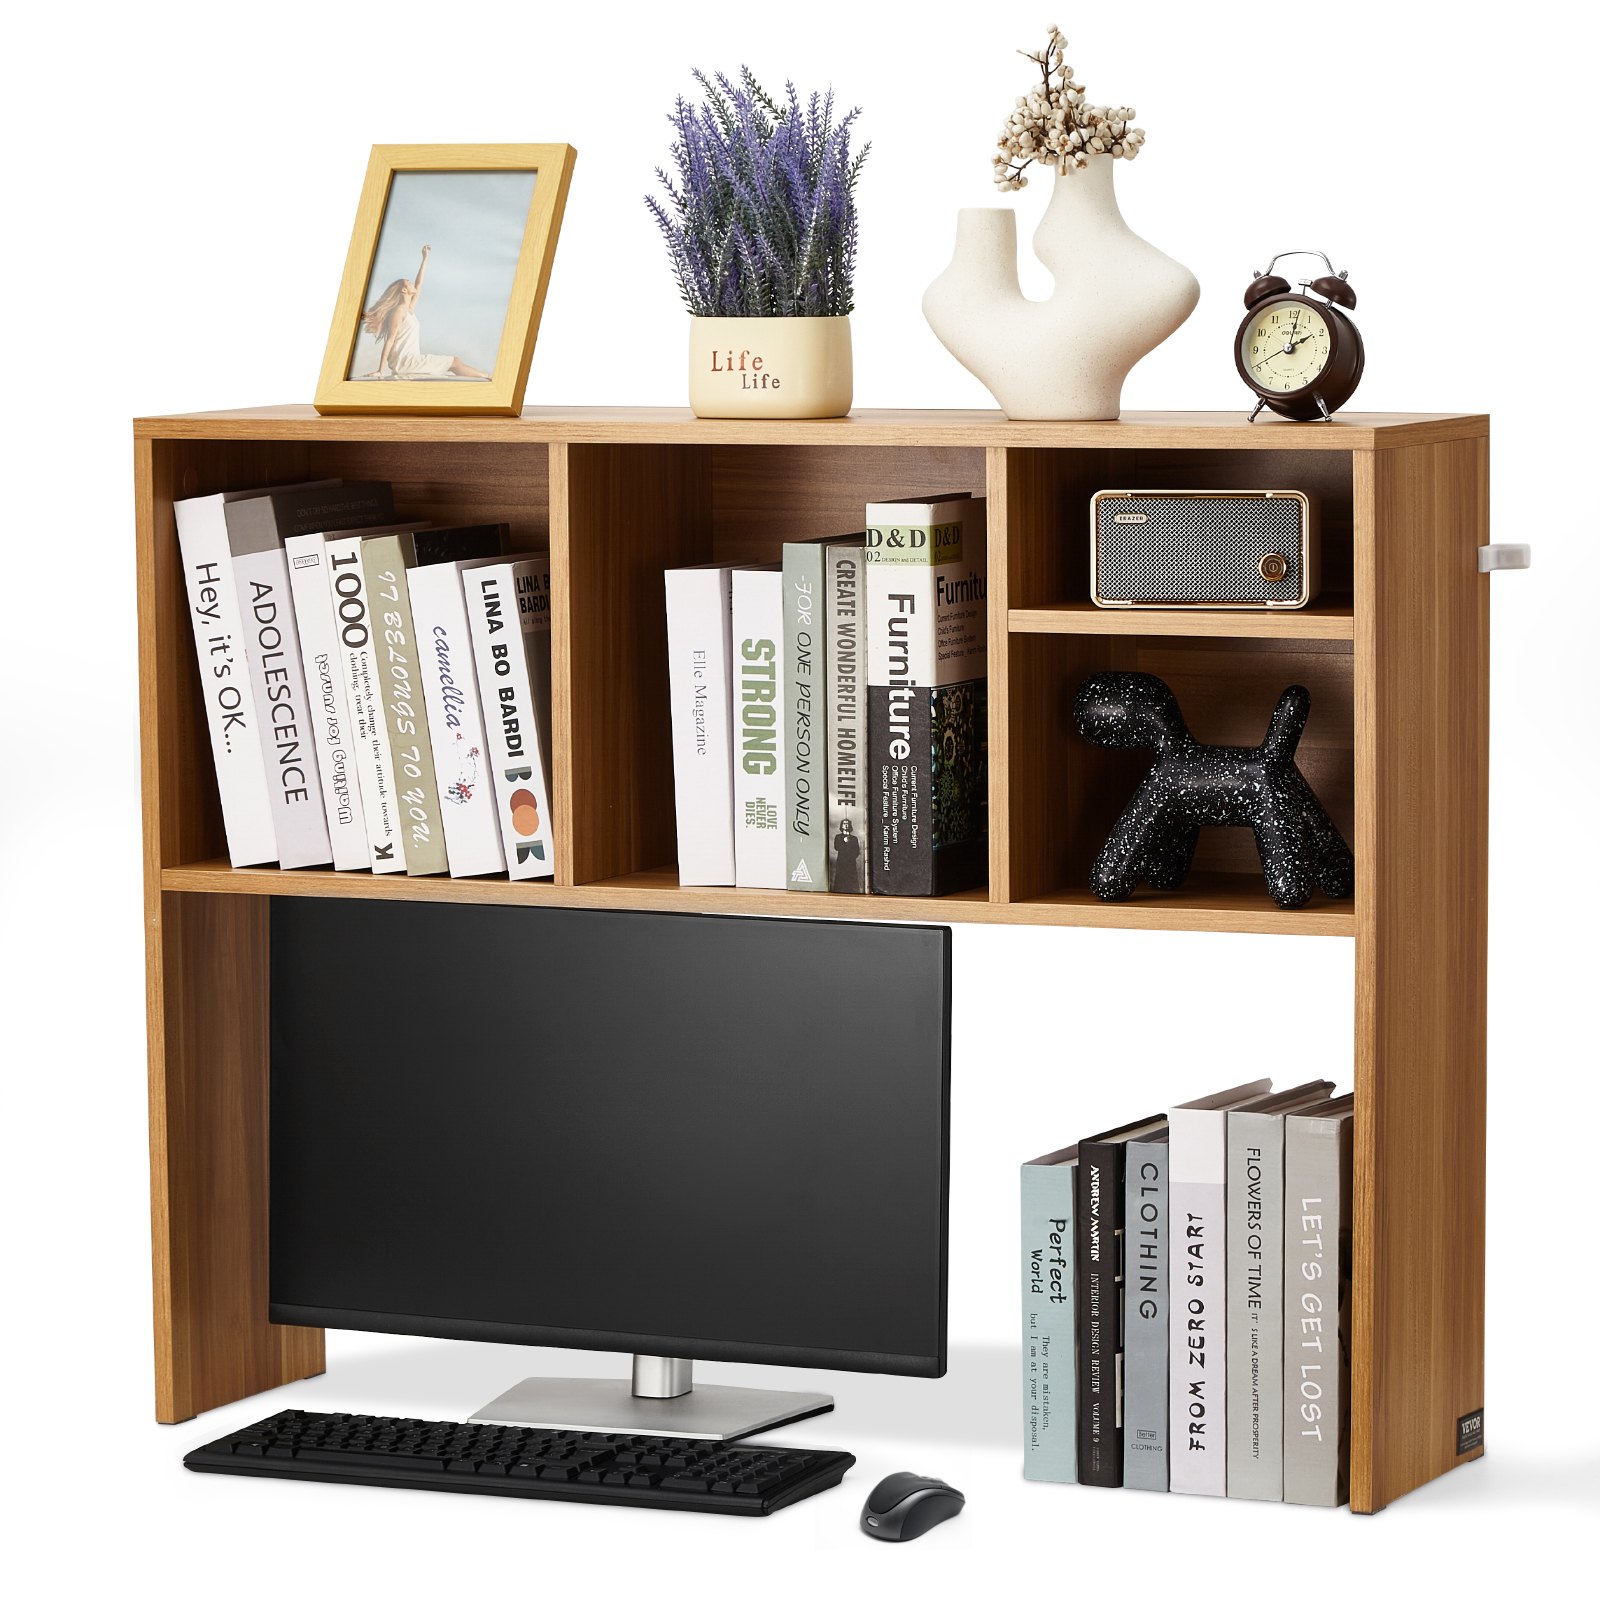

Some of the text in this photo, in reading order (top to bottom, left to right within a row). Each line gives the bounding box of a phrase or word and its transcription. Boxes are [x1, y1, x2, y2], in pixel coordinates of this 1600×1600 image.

[1257, 328, 1267, 337] 10
[1271, 316, 1279, 324] 11
[1319, 329, 1324, 337] 2
[711, 350, 764, 371] Life
[1253, 346, 1259, 354] 9
[1322, 346, 1328, 354] 3
[742, 373, 781, 389] Life
[1268, 376, 1274, 385] 7
[1301, 376, 1309, 385] 5
[1316, 364, 1322, 372] 4
[1284, 382, 1290, 390] 6
[866, 550, 881, 563] 02
[330, 551, 369, 648] 1000
[516, 574, 539, 594] LINA
[481, 579, 504, 635] LINA
[195, 562, 246, 754] Hey, it's OK...
[491, 643, 511, 677] BO
[796, 632, 812, 676] ONE
[383, 610, 416, 736] BELONGS
[432, 625, 465, 731] camellia
[835, 559, 857, 807] CREATE WONDERFUL HOMELIFE
[887, 593, 917, 760] Furniture
[249, 581, 309, 805] ADOLESCENCE
[355, 694, 364, 715] treat
[692, 649, 709, 756] Elle Magazine
[741, 638, 777, 775] STRONG
[358, 719, 367, 740] their
[498, 686, 525, 758] BARDI
[795, 681, 811, 774] PERSON
[314, 653, 353, 825] Waiting for sunset
[360, 651, 393, 837] Completely change their attitude towards
[401, 745, 422, 778] TO
[891, 765, 899, 785] Office
[910, 765, 918, 791] Current
[401, 787, 430, 849] YOU.
[745, 801, 756, 829] DIES.
[755, 797, 766, 829] NEVER
[766, 804, 778, 830] LOVE
[882, 791, 890, 818] Feature
[901, 789, 909, 820] Furniture
[891, 818, 900, 844] System
[910, 824, 919, 849] Design
[883, 846, 891, 871] Rashid
[1090, 1164, 1100, 1217] ANDREW
[1246, 1147, 1262, 1231] FLOWERS
[1090, 1217, 1100, 1262] MARTIN
[1139, 1162, 1159, 1321] CLOTHING
[1247, 1234, 1262, 1260] OF
[1030, 1248, 1044, 1294] World
[1048, 1218, 1068, 1304] Perfect
[1090, 1272, 1100, 1317] INTERIOR
[1248, 1264, 1262, 1309] TIME
[1030, 1313, 1038, 1329] but
[1186, 1212, 1207, 1451] FROM ZERO START
[1300, 1198, 1323, 1442] LET'S GET LOST
[1030, 1345, 1037, 1357] am
[1042, 1335, 1051, 1358] They
[1091, 1321, 1100, 1355] DESIGN
[1251, 1333, 1259, 1349] LIKE
[1030, 1361, 1037, 1373] at
[1091, 1359, 1100, 1394] REVIEW
[1029, 1378, 1037, 1400] your
[1042, 1383, 1051, 1431] mistaken,
[1092, 1402, 1100, 1435] VOLUME
[1031, 1404, 1040, 1451] disposal.
[1461, 1416, 1481, 1435] VEVOR
[1131, 1443, 1163, 1452] CLOTHING
